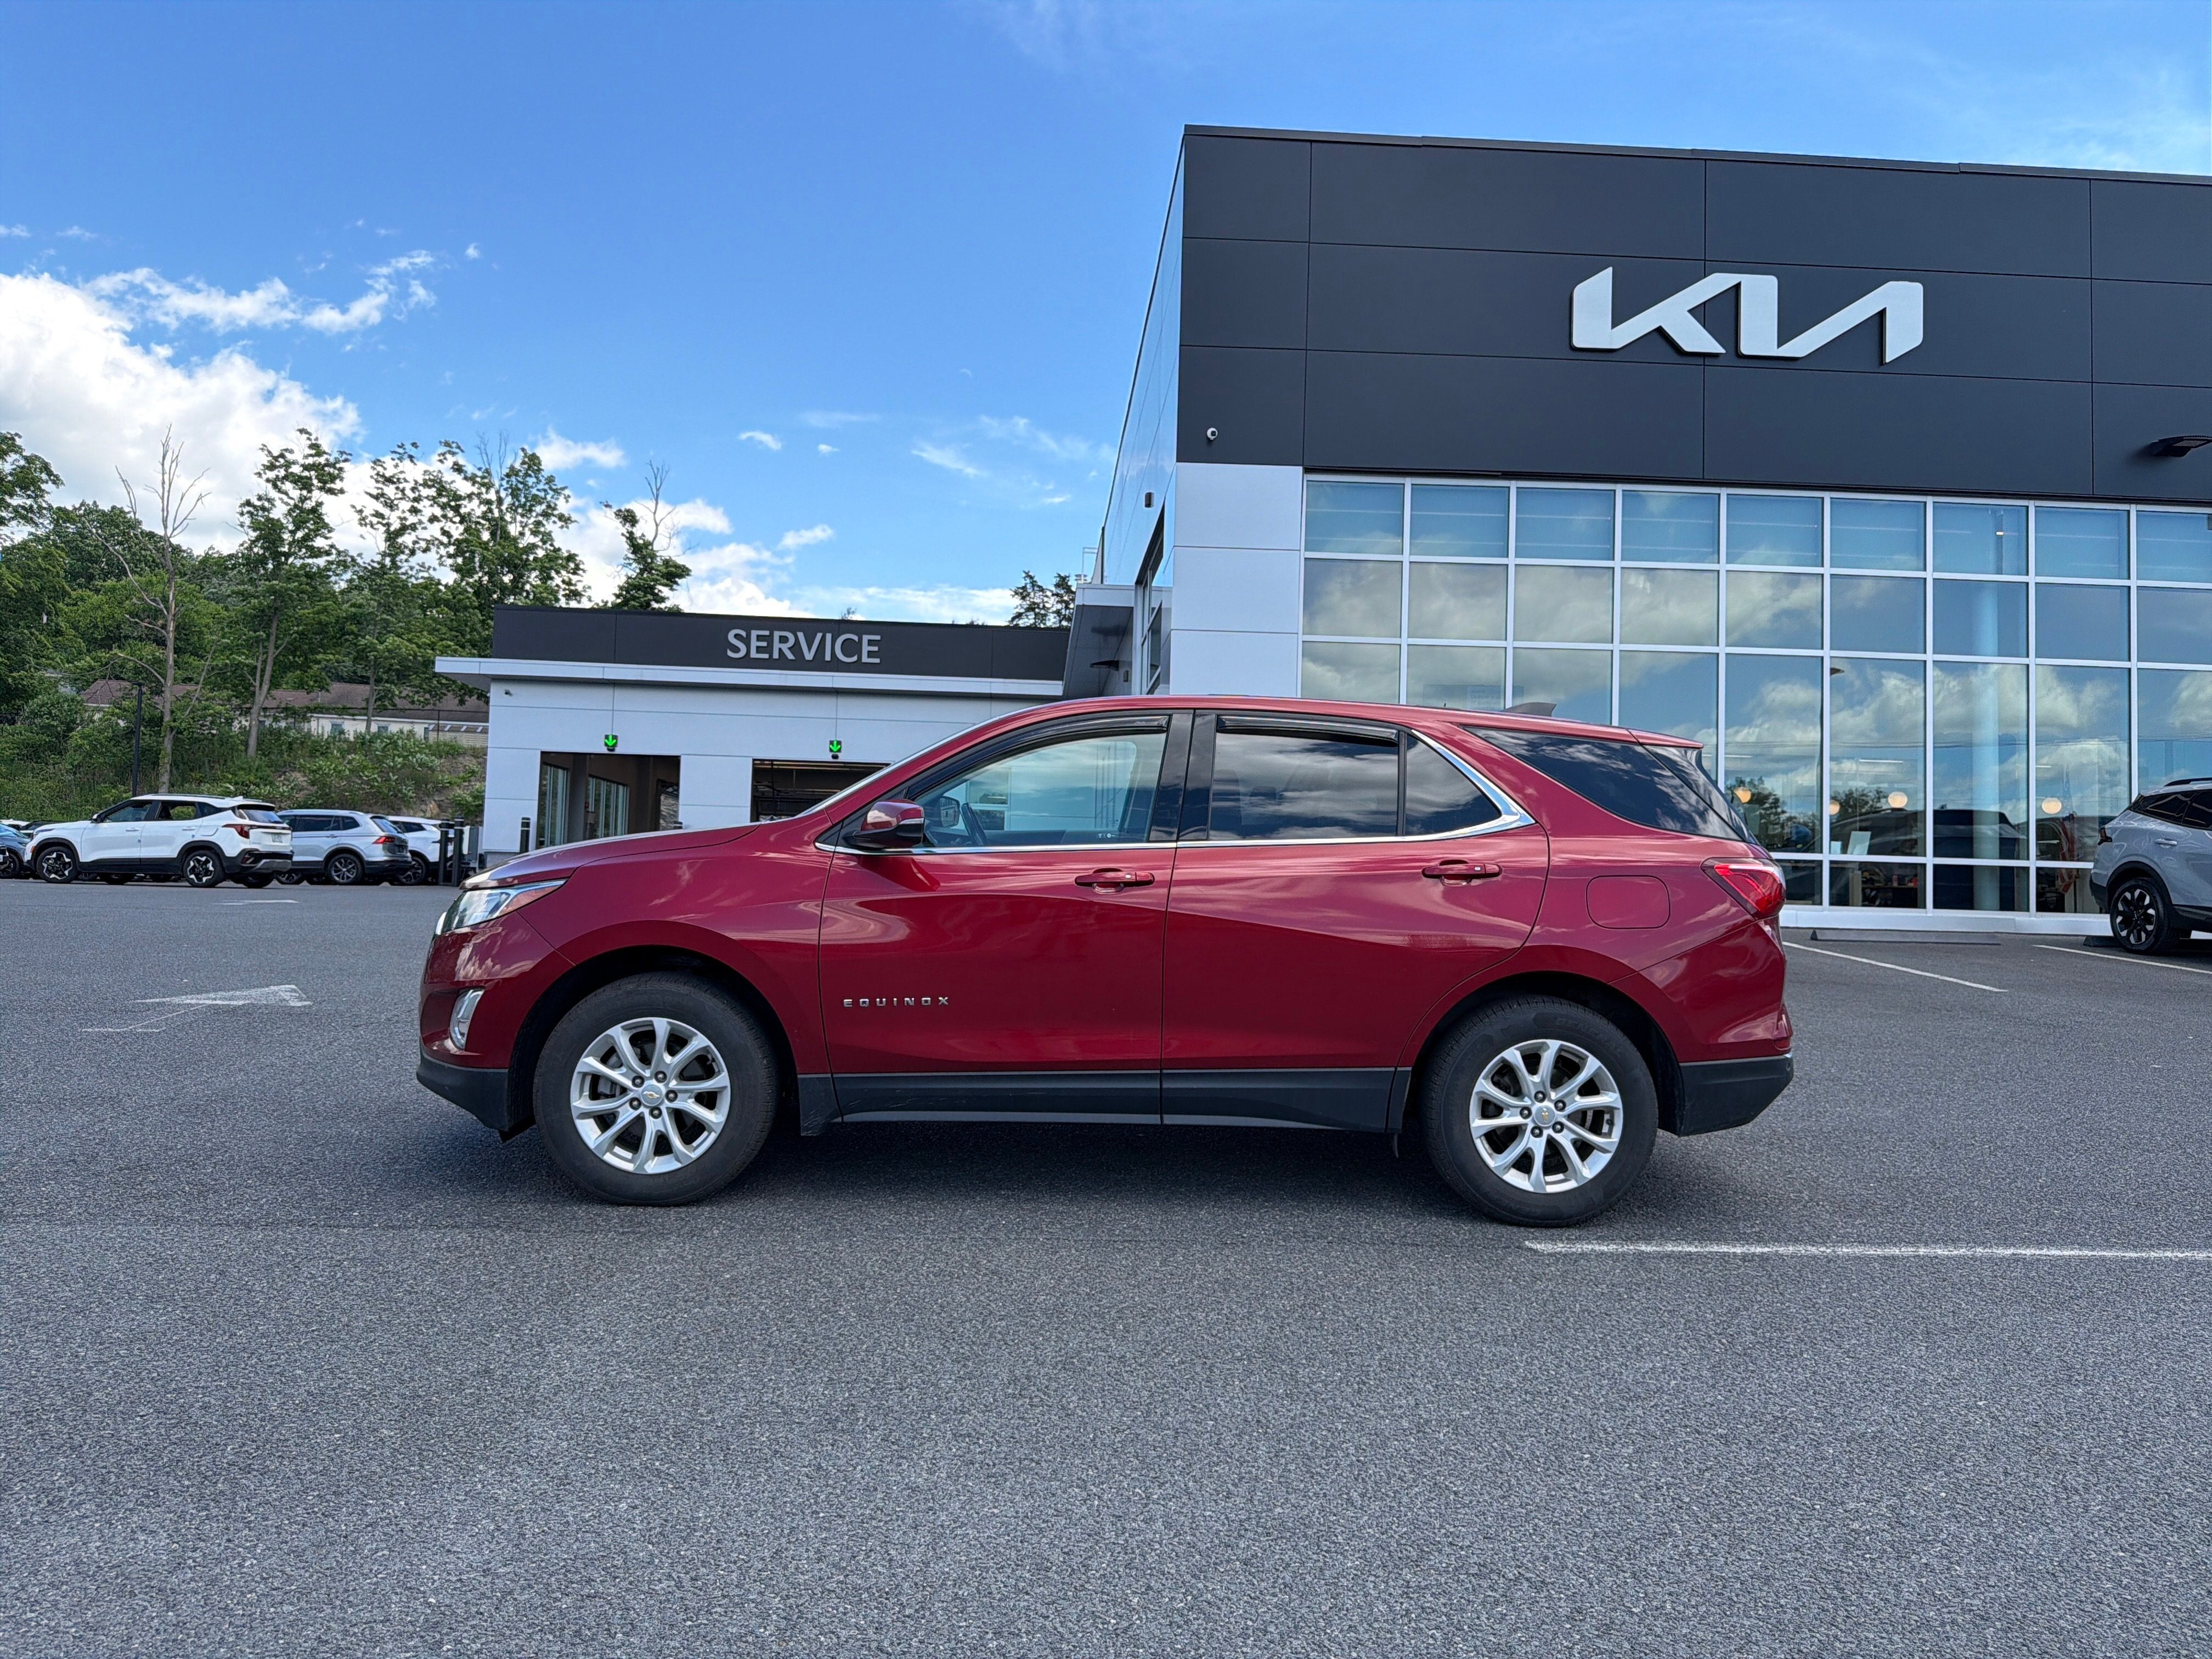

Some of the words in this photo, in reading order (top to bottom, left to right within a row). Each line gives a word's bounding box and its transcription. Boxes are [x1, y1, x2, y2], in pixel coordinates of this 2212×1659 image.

[1572, 267, 1923, 363] KIA
[727, 629, 881, 663] SERVICE
[843, 996, 949, 1007] EQUINOX
